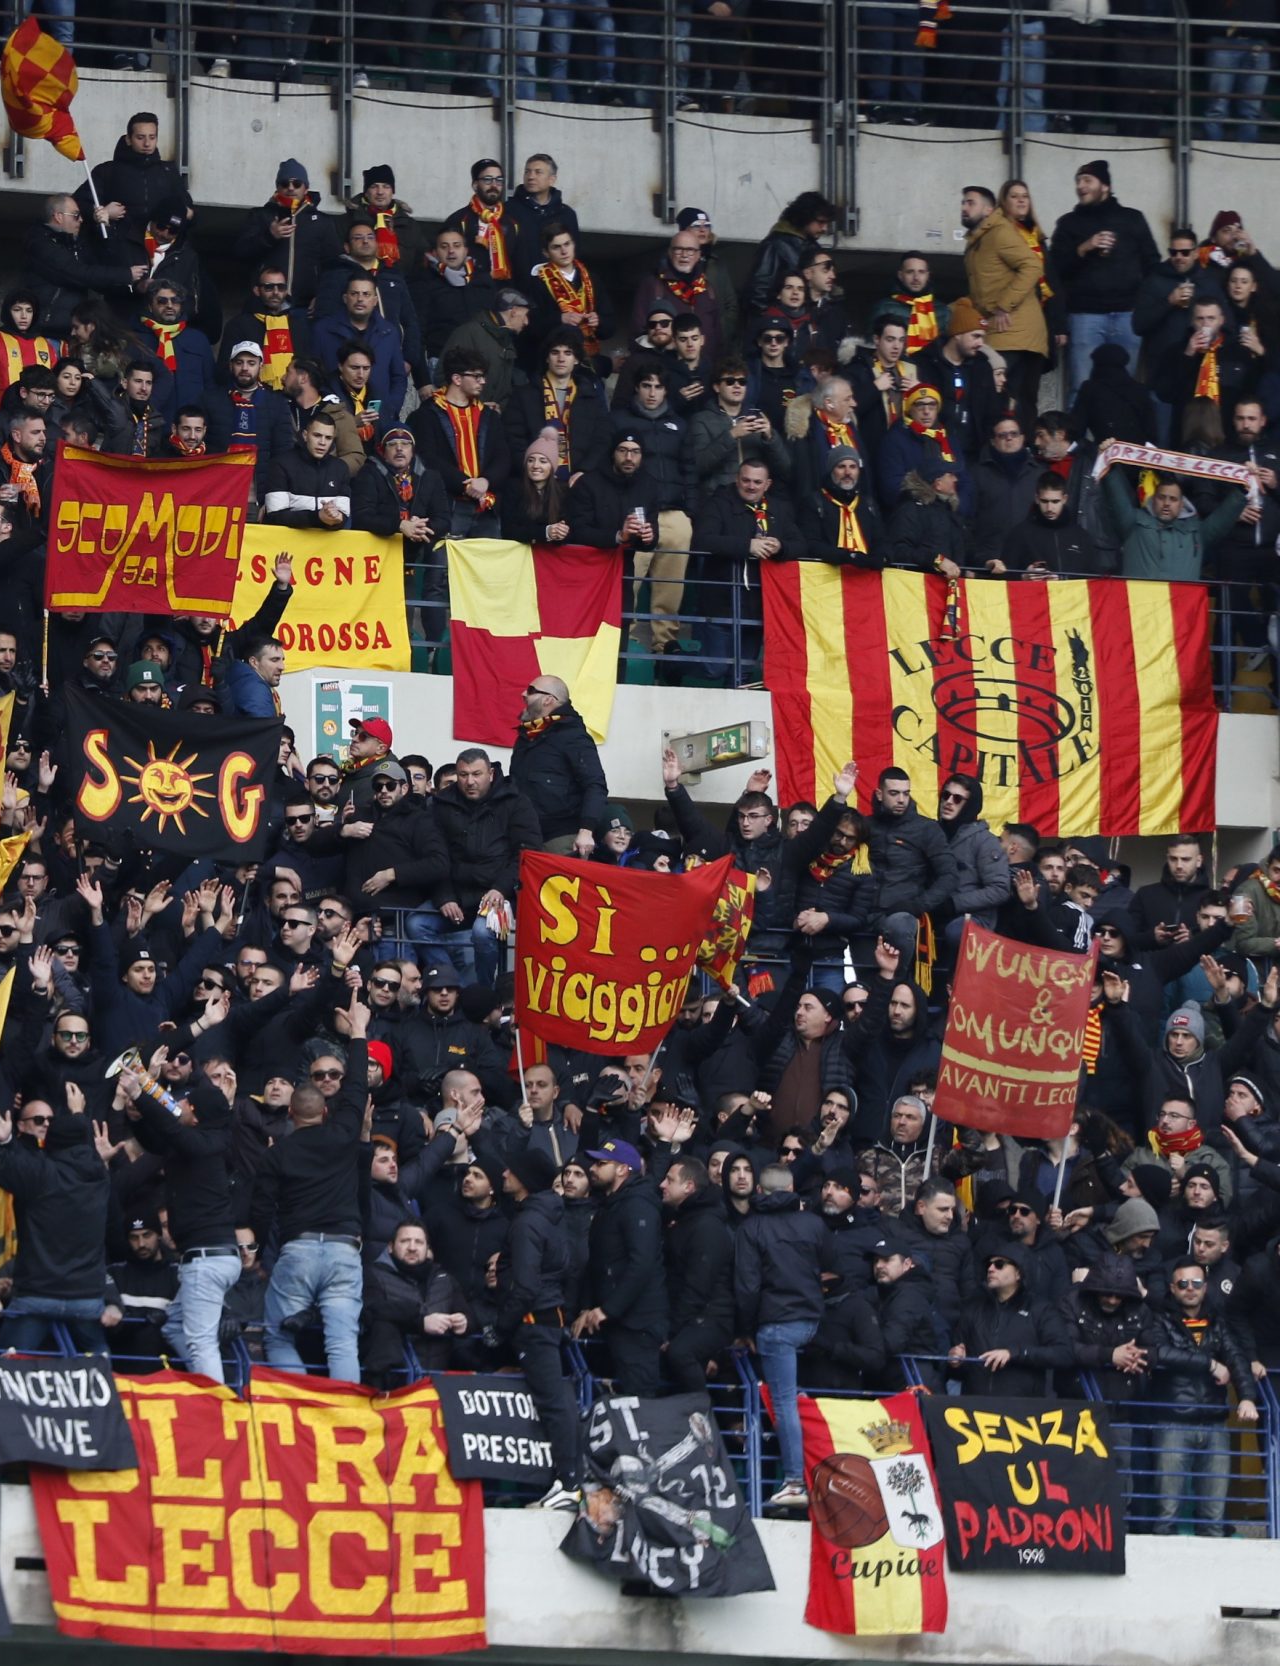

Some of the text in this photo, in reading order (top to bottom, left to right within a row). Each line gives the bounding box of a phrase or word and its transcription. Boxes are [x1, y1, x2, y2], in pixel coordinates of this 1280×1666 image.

[236, 554, 381, 586] SGNE
[888, 634, 1057, 678] LECCE
[892, 705, 1101, 788] CAPITALE
[946, 1003, 1085, 1062] OMUNQU
[940, 1064, 1029, 1105] AVANTI
[22, 1413, 99, 1458] VIVE
[462, 1432, 554, 1469] PRESENT
[944, 1407, 1109, 1466] SENZA
[953, 1501, 1114, 1561] PADRONI
[56, 1500, 469, 1616] LECCE
